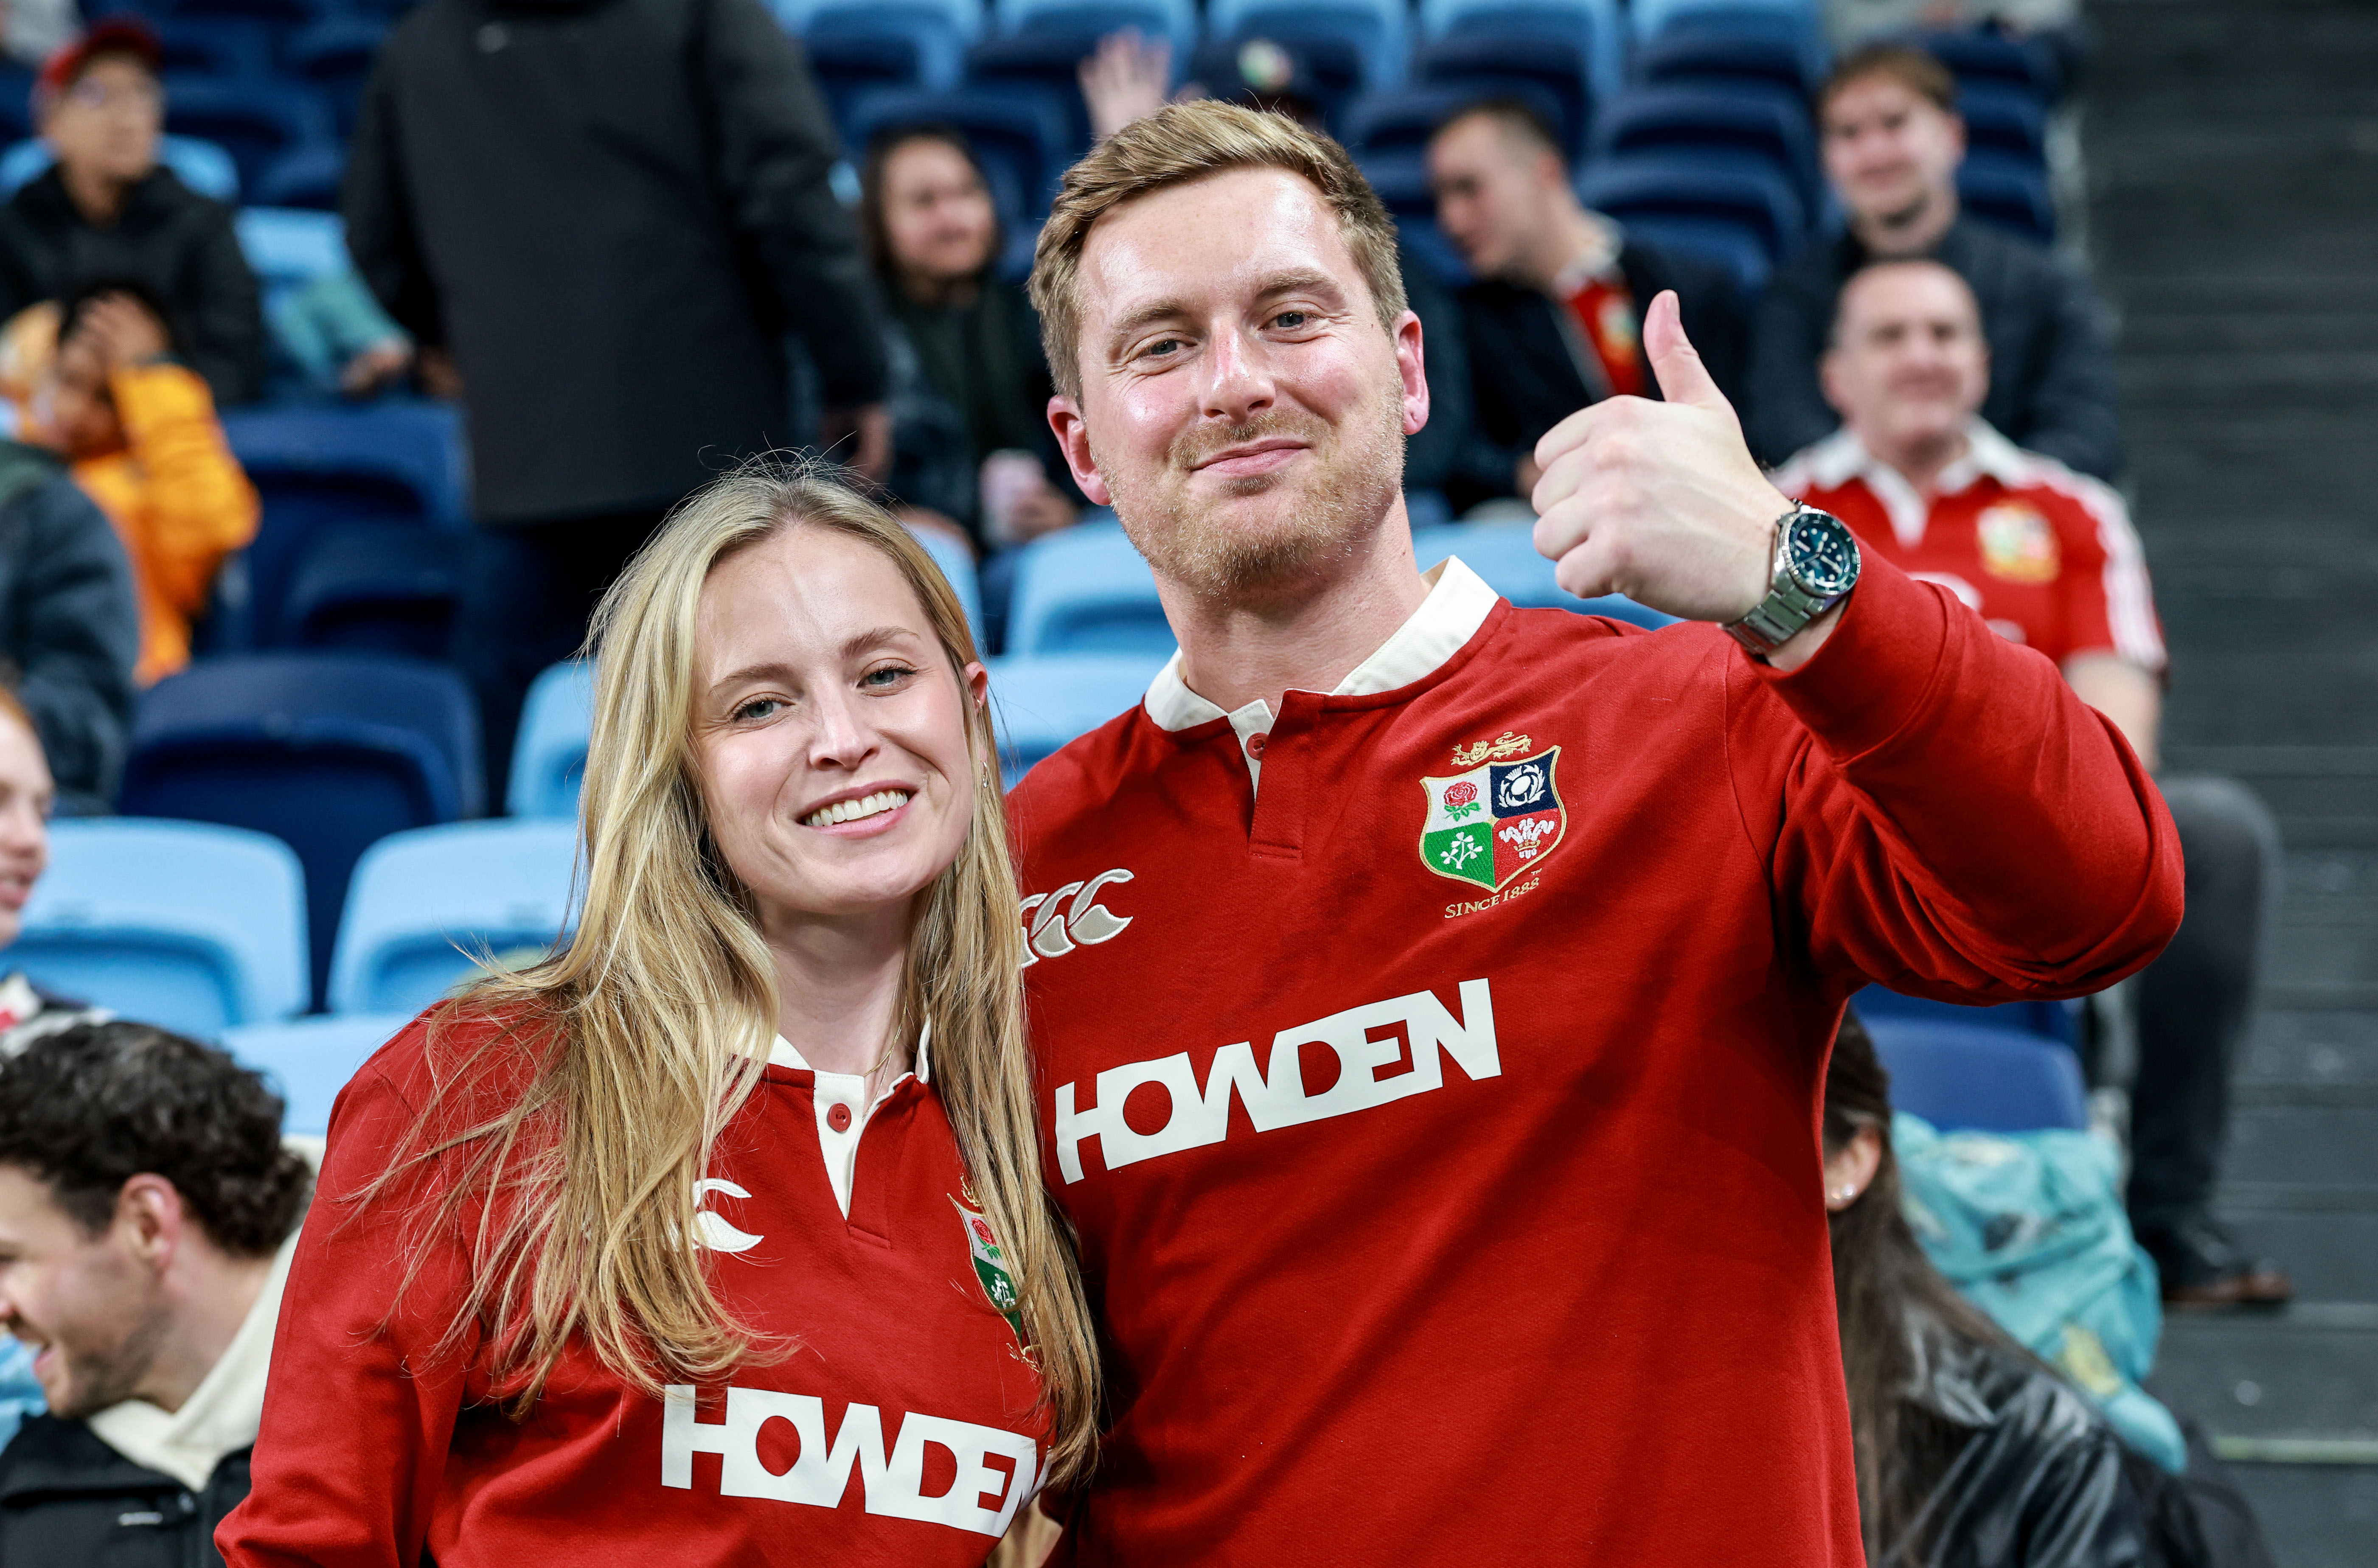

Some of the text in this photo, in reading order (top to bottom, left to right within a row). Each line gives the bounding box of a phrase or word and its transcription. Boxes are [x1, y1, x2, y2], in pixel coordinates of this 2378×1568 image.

[1444, 877, 1540, 919] SINCE 1888
[1055, 977, 1502, 1184] HOWDEN
